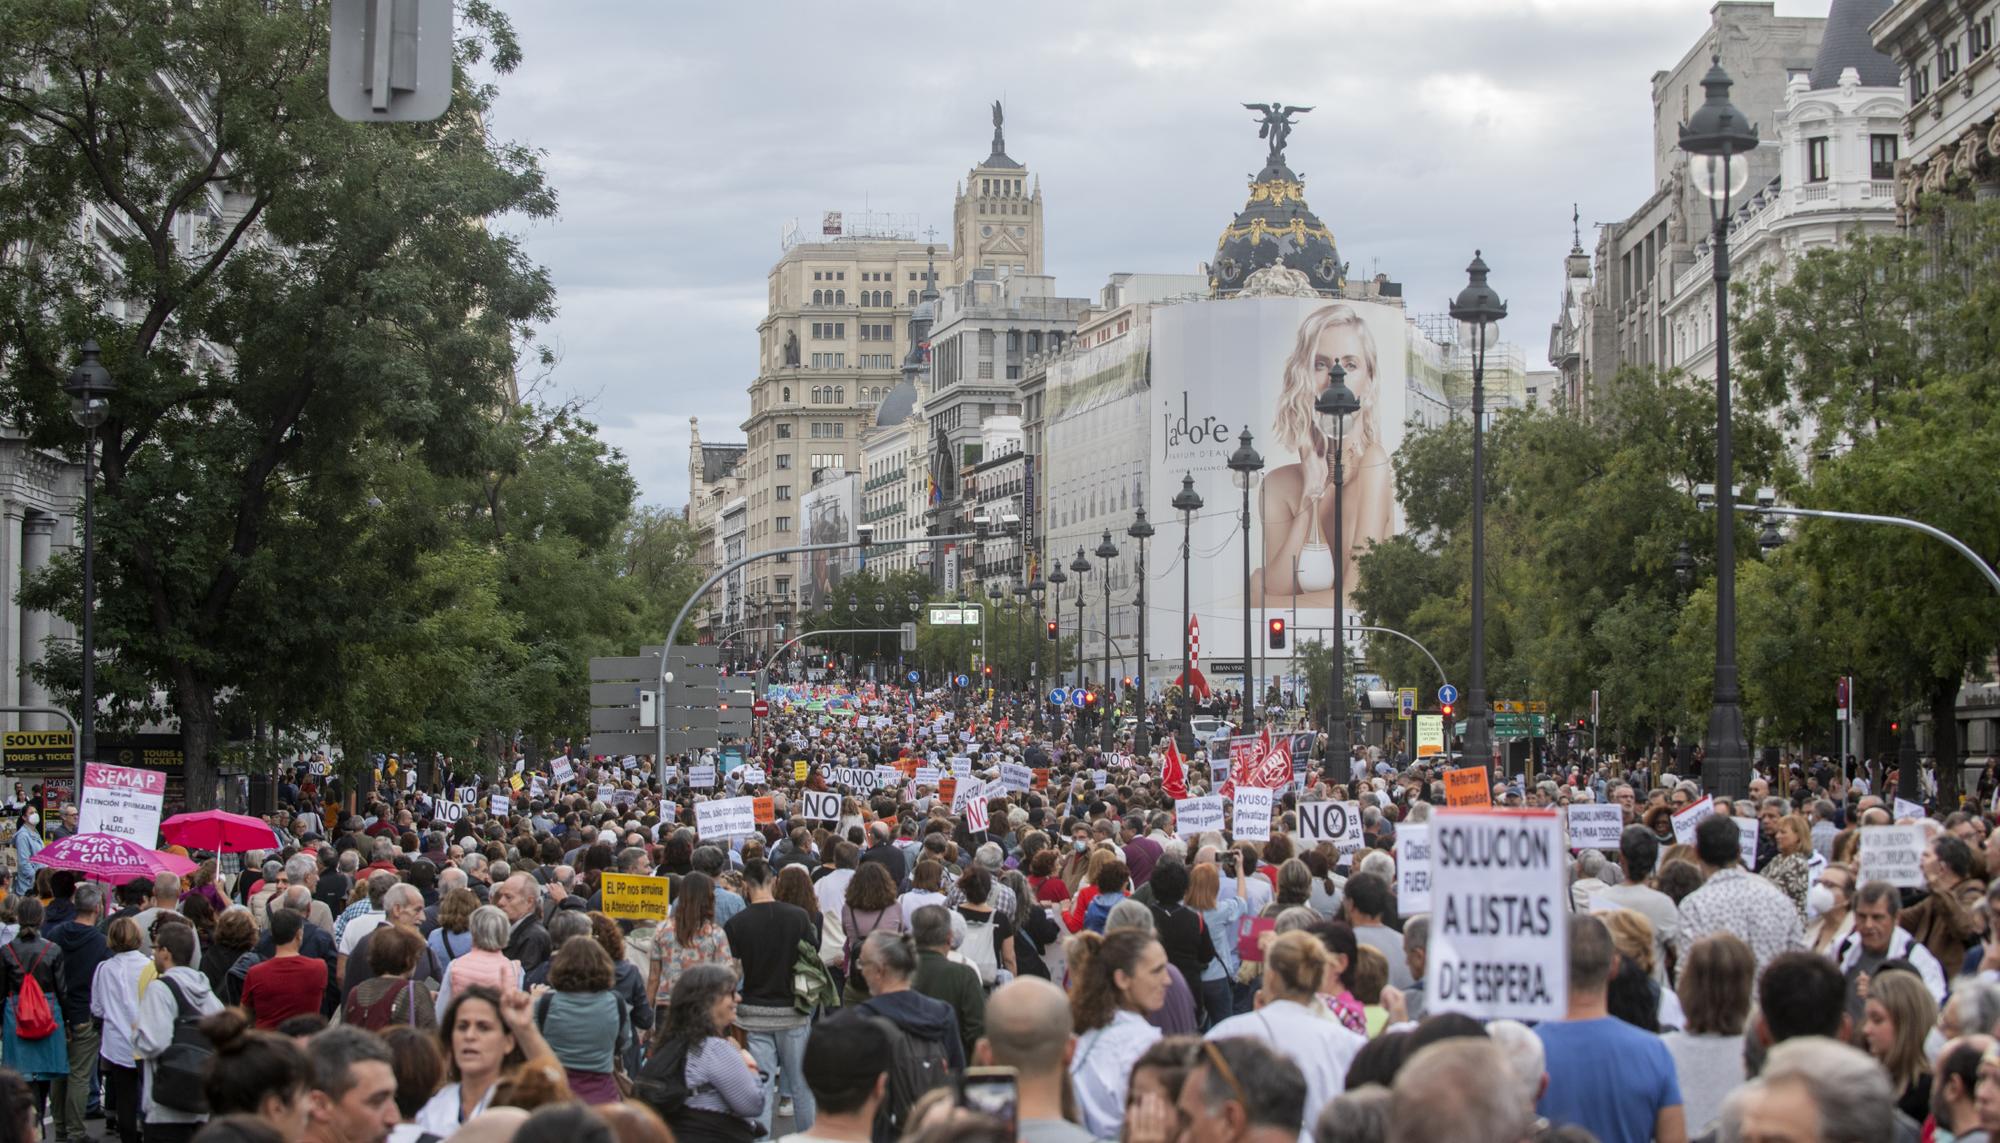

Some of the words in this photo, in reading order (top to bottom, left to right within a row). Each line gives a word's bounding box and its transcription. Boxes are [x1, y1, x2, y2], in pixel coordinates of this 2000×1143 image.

[6, 734, 73, 747] SOUVENI
[6, 753, 36, 761] TOURS
[143, 757, 183, 765] TICKETS
[1101, 753, 1119, 765] NO
[310, 763, 325, 774] NO
[96, 768, 156, 788] SEMAP
[836, 770, 851, 783] NO
[852, 771, 874, 787] NO
[436, 801, 461, 822] NO
[804, 793, 840, 819] NO
[1299, 804, 1347, 838] NO
[100, 823, 135, 835] CALIDAD
[1236, 827, 1244, 835] es
[80, 852, 146, 866] CALIDAD
[607, 881, 616, 895] EL
[616, 882, 626, 895] PP
[627, 885, 639, 895] nos
[604, 900, 610, 912] la
[611, 900, 639, 913] Atención
[640, 900, 666, 914] Primaria
[1443, 894, 1460, 936] A
[1466, 895, 1552, 937] LISTAS
[1439, 961, 1467, 1001] DE
